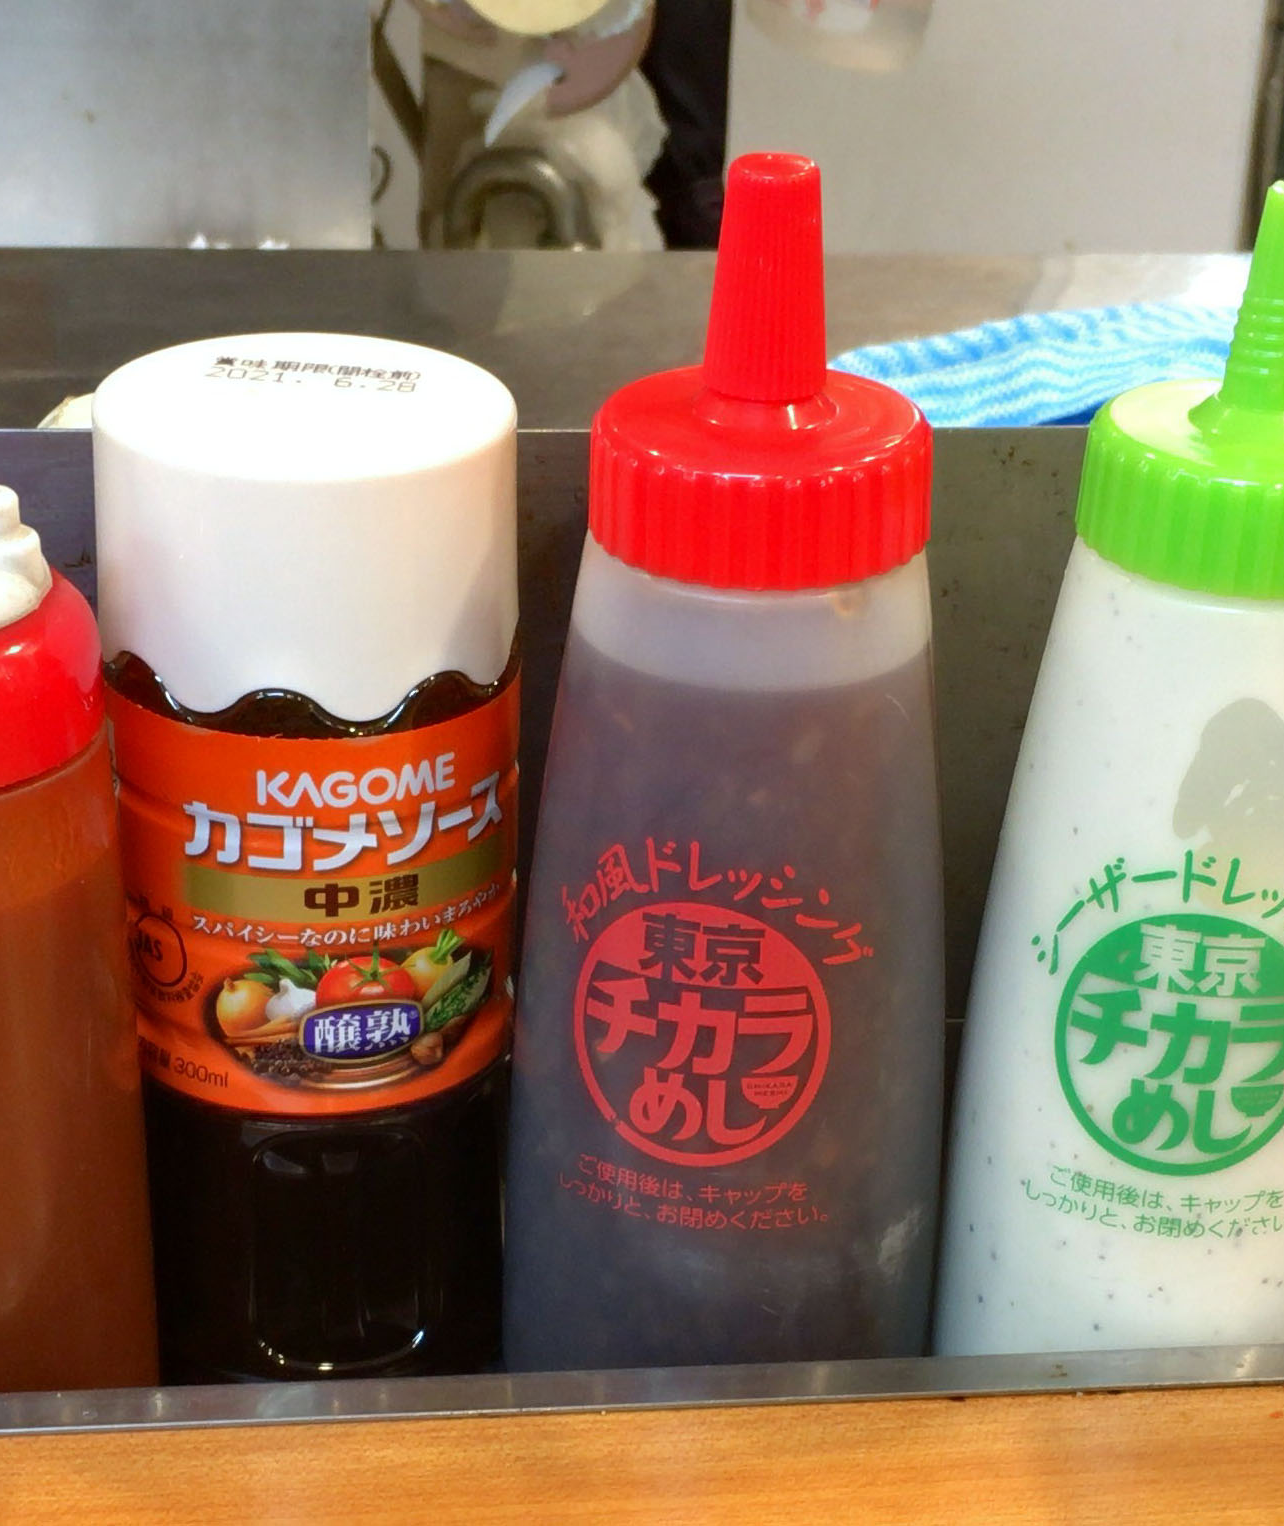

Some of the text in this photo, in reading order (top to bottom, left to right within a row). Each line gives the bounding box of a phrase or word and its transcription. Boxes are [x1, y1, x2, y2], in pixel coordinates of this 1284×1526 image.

[205, 366, 417, 393] 2021. 6.28
[215, 356, 421, 381] 賞味期限(開栓前)
[255, 752, 455, 809] KAGOME
[183, 771, 503, 871] カゴメソース
[192, 883, 500, 946] スパイシーなのに味わいまろやか
[303, 874, 419, 918] 中濃
[562, 837, 875, 965] 和風ドレッシング
[639, 911, 766, 986] 東京
[1134, 923, 1266, 996] 東京
[314, 1008, 412, 1054] 醸熟
[585, 975, 814, 1076] チカラ
[174, 1057, 229, 1089] 300ml
[630, 1066, 768, 1146] めし
[1112, 1078, 1253, 1155] めし
[559, 1172, 829, 1231] しっかりと、お閉めください。
[578, 1153, 809, 1206] ご使用後は、キャップを
